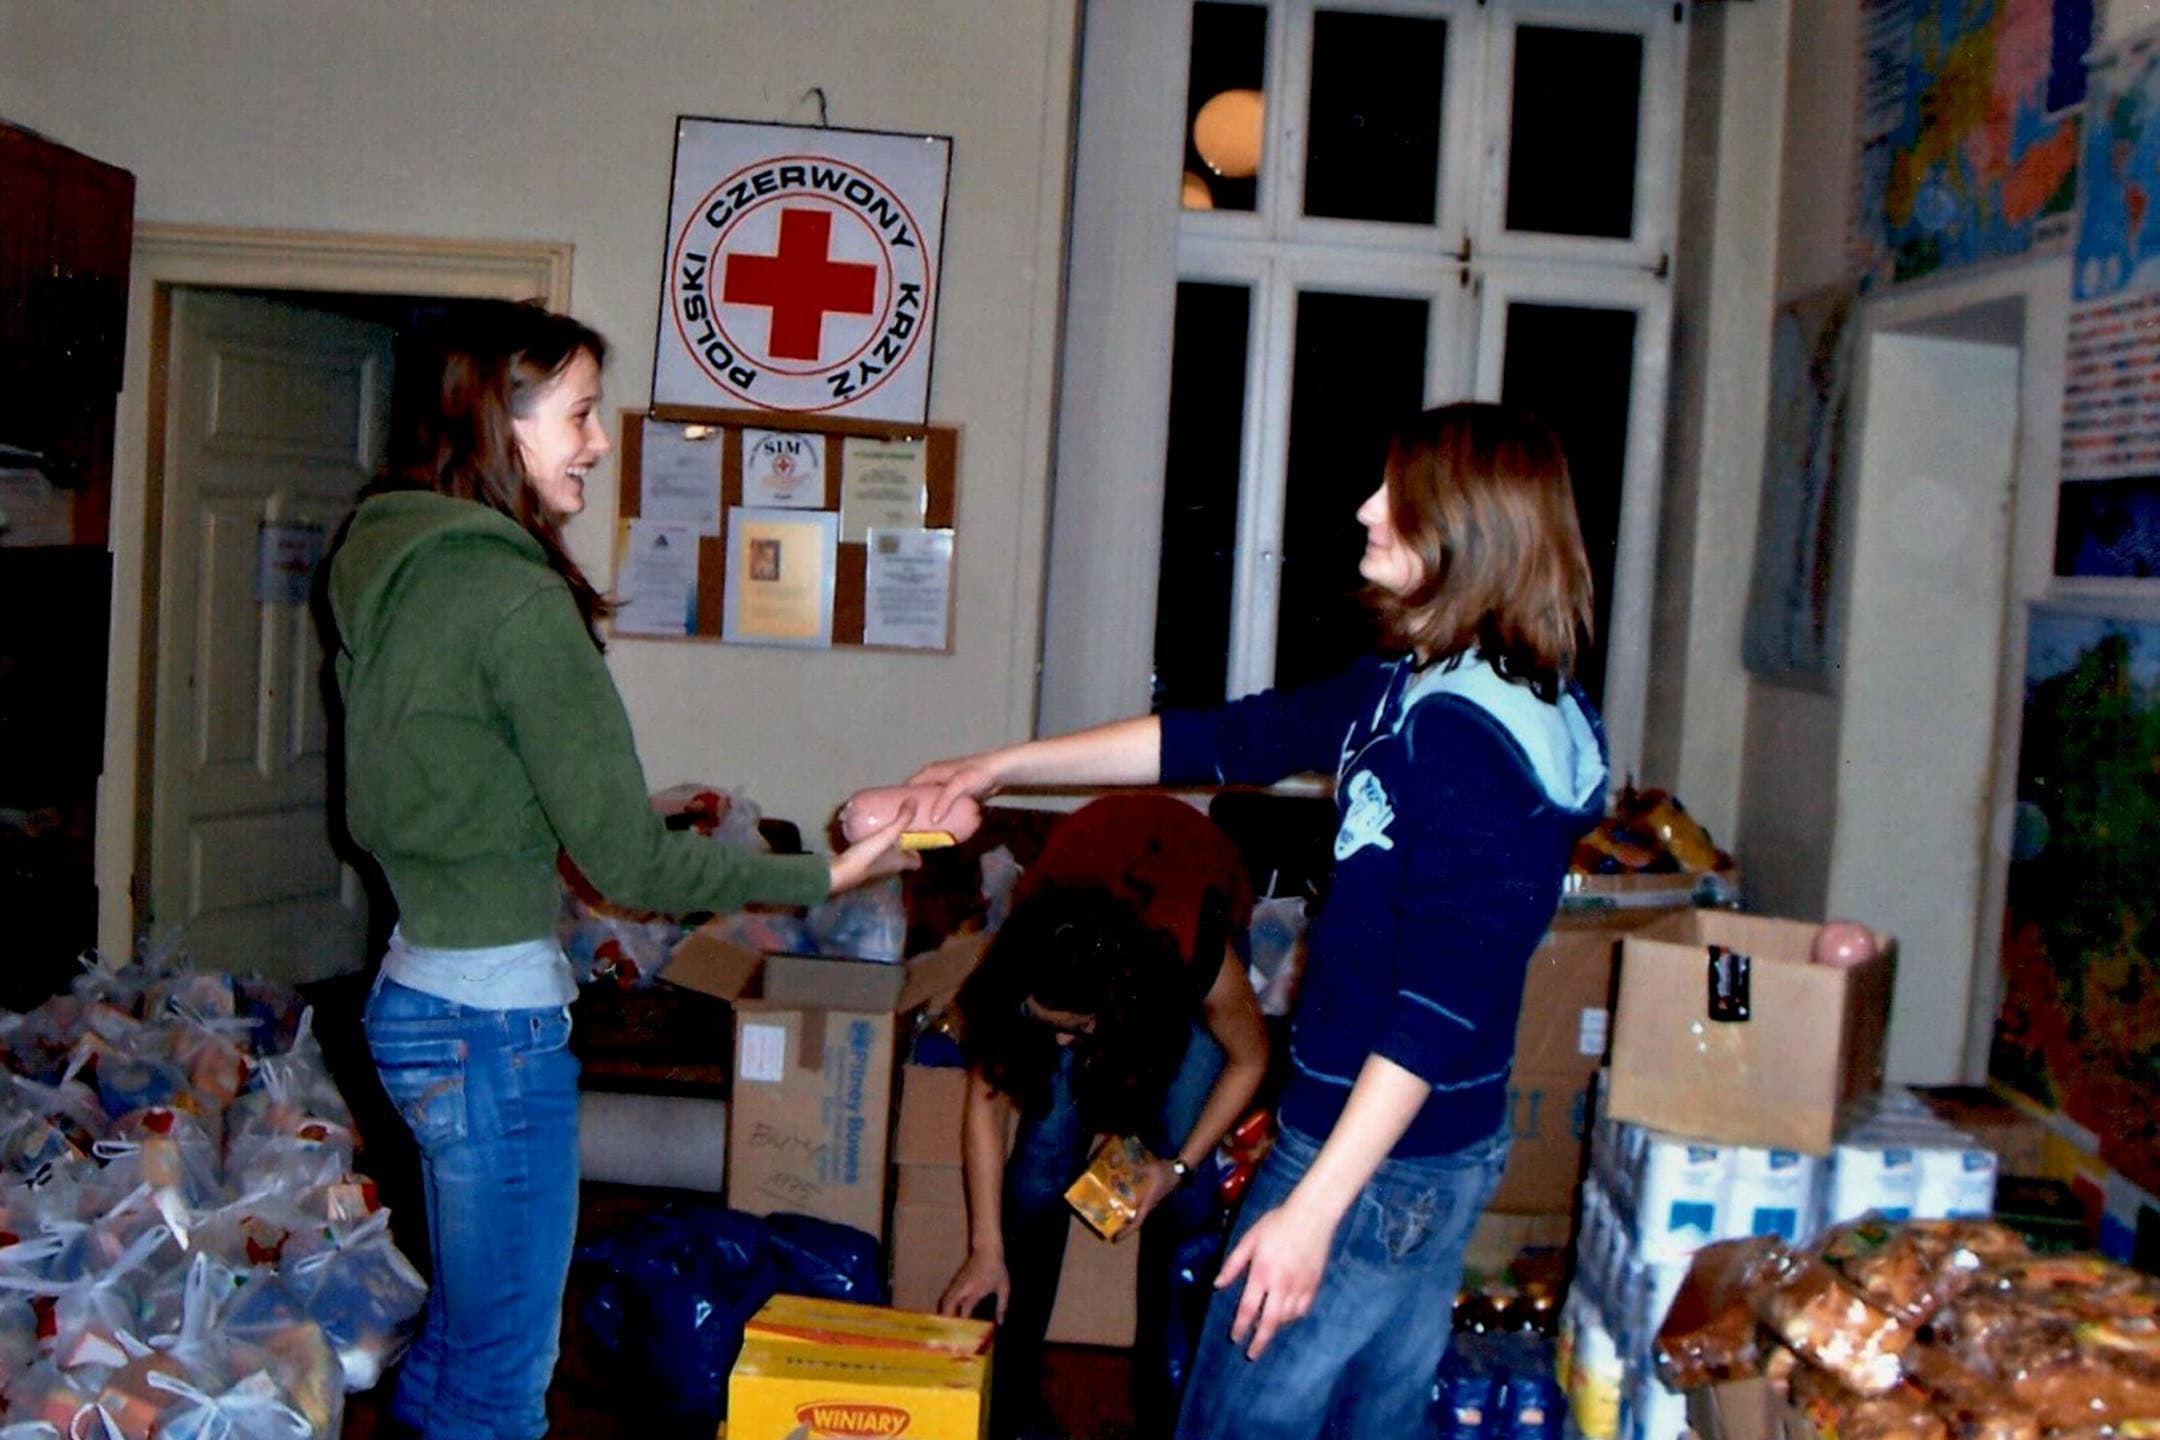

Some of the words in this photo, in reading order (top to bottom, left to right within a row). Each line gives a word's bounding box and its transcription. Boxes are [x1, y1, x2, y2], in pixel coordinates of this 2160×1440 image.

[705, 165, 915, 248] CZERWONY
[682, 252, 756, 390] POLSKI
[827, 283, 921, 400] KRZYŻ
[764, 440, 801, 456] SIM
[813, 1407, 907, 1432] WINIARY
